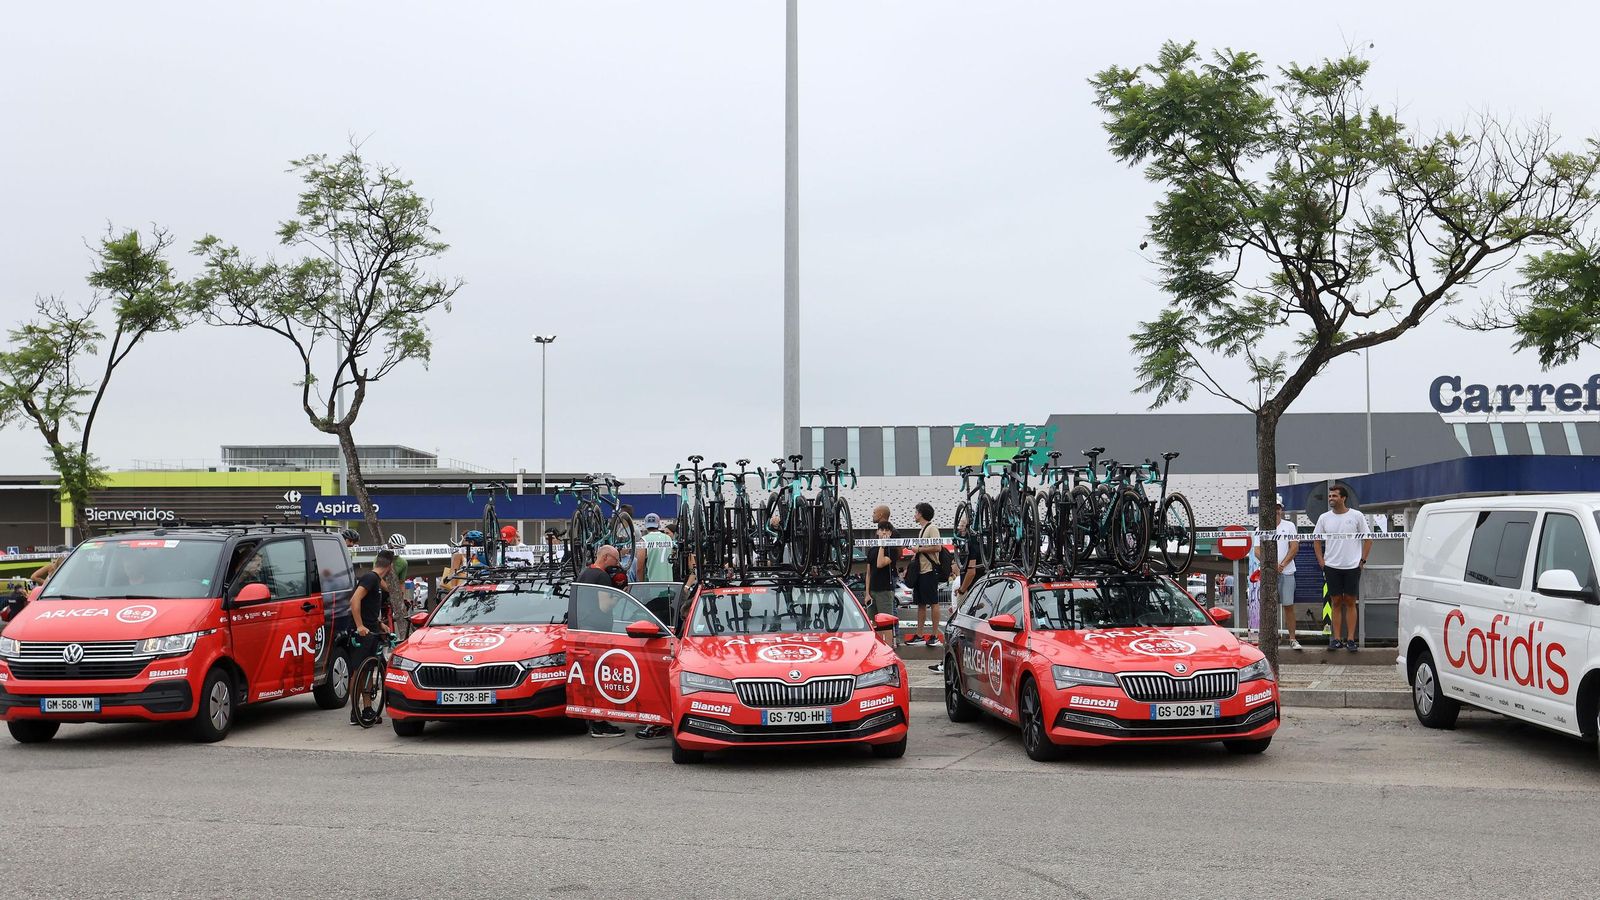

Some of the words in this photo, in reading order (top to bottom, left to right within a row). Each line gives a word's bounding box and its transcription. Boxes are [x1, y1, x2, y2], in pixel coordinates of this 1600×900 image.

[84, 507, 175, 521] Bienvenidos
[314, 500, 380, 516] Aspirao
[1306, 532, 1324, 540] LOCAL
[34, 608, 110, 621] ARKEA
[723, 636, 848, 647] ARKEA
[1084, 629, 1209, 641] ARKEA
[1443, 608, 1569, 696] Cofidis
[963, 646, 987, 675] ARKEA
[149, 667, 188, 677] Bianchi
[386, 672, 409, 682] Bianchi
[531, 670, 567, 680] Bianchi
[567, 661, 586, 685] A
[601, 665, 634, 684] B&B
[604, 683, 630, 692] HOTELS
[443, 692, 490, 703] GS-738-BF
[859, 694, 894, 708] Bianchi
[1070, 695, 1119, 708] Bianchi
[1245, 688, 1272, 703] Bianchi
[47, 700, 93, 710] GM-568-VM
[690, 701, 732, 713] Bianchi
[769, 710, 825, 723] GS-790-HH
